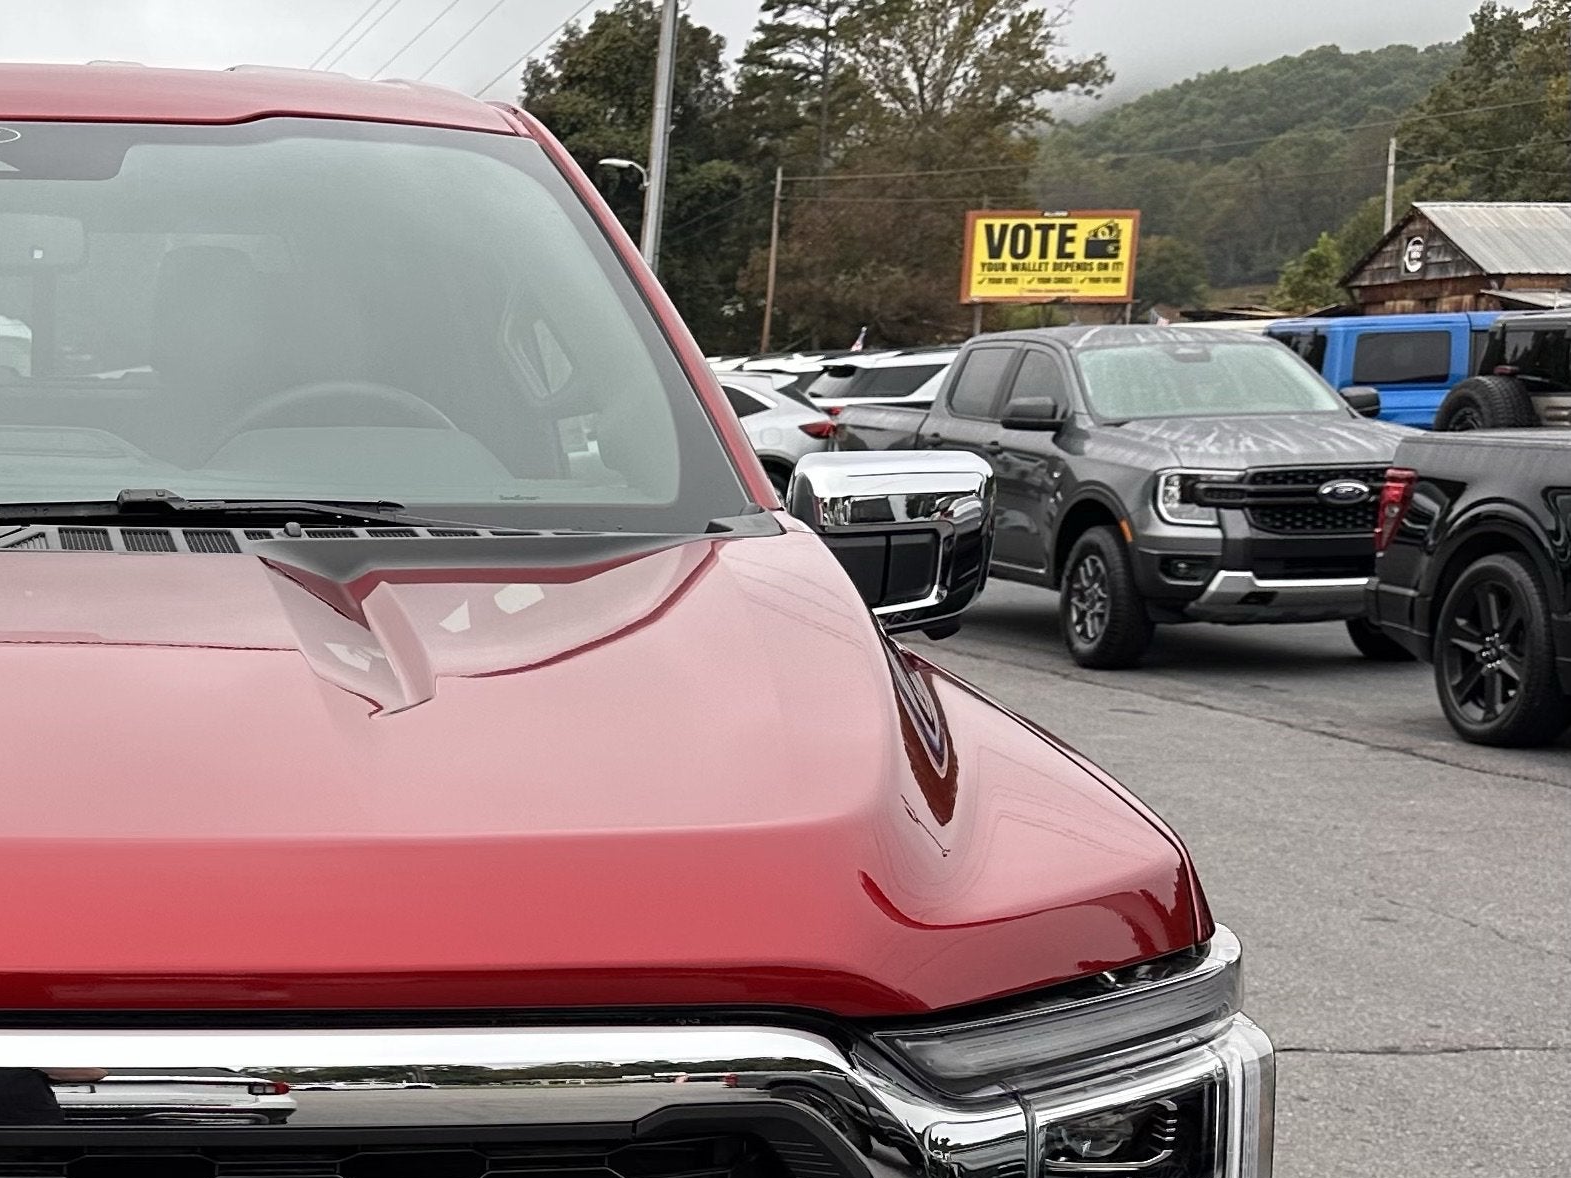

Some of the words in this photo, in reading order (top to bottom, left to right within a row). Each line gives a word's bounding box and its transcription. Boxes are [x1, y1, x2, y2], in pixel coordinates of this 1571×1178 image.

[984, 223, 1078, 259] VOTE
[980, 262, 1006, 272] YOUR
[1011, 262, 1049, 272] WALLET
[1052, 262, 1094, 272] DEPENDS
[1097, 262, 1109, 272] ON
